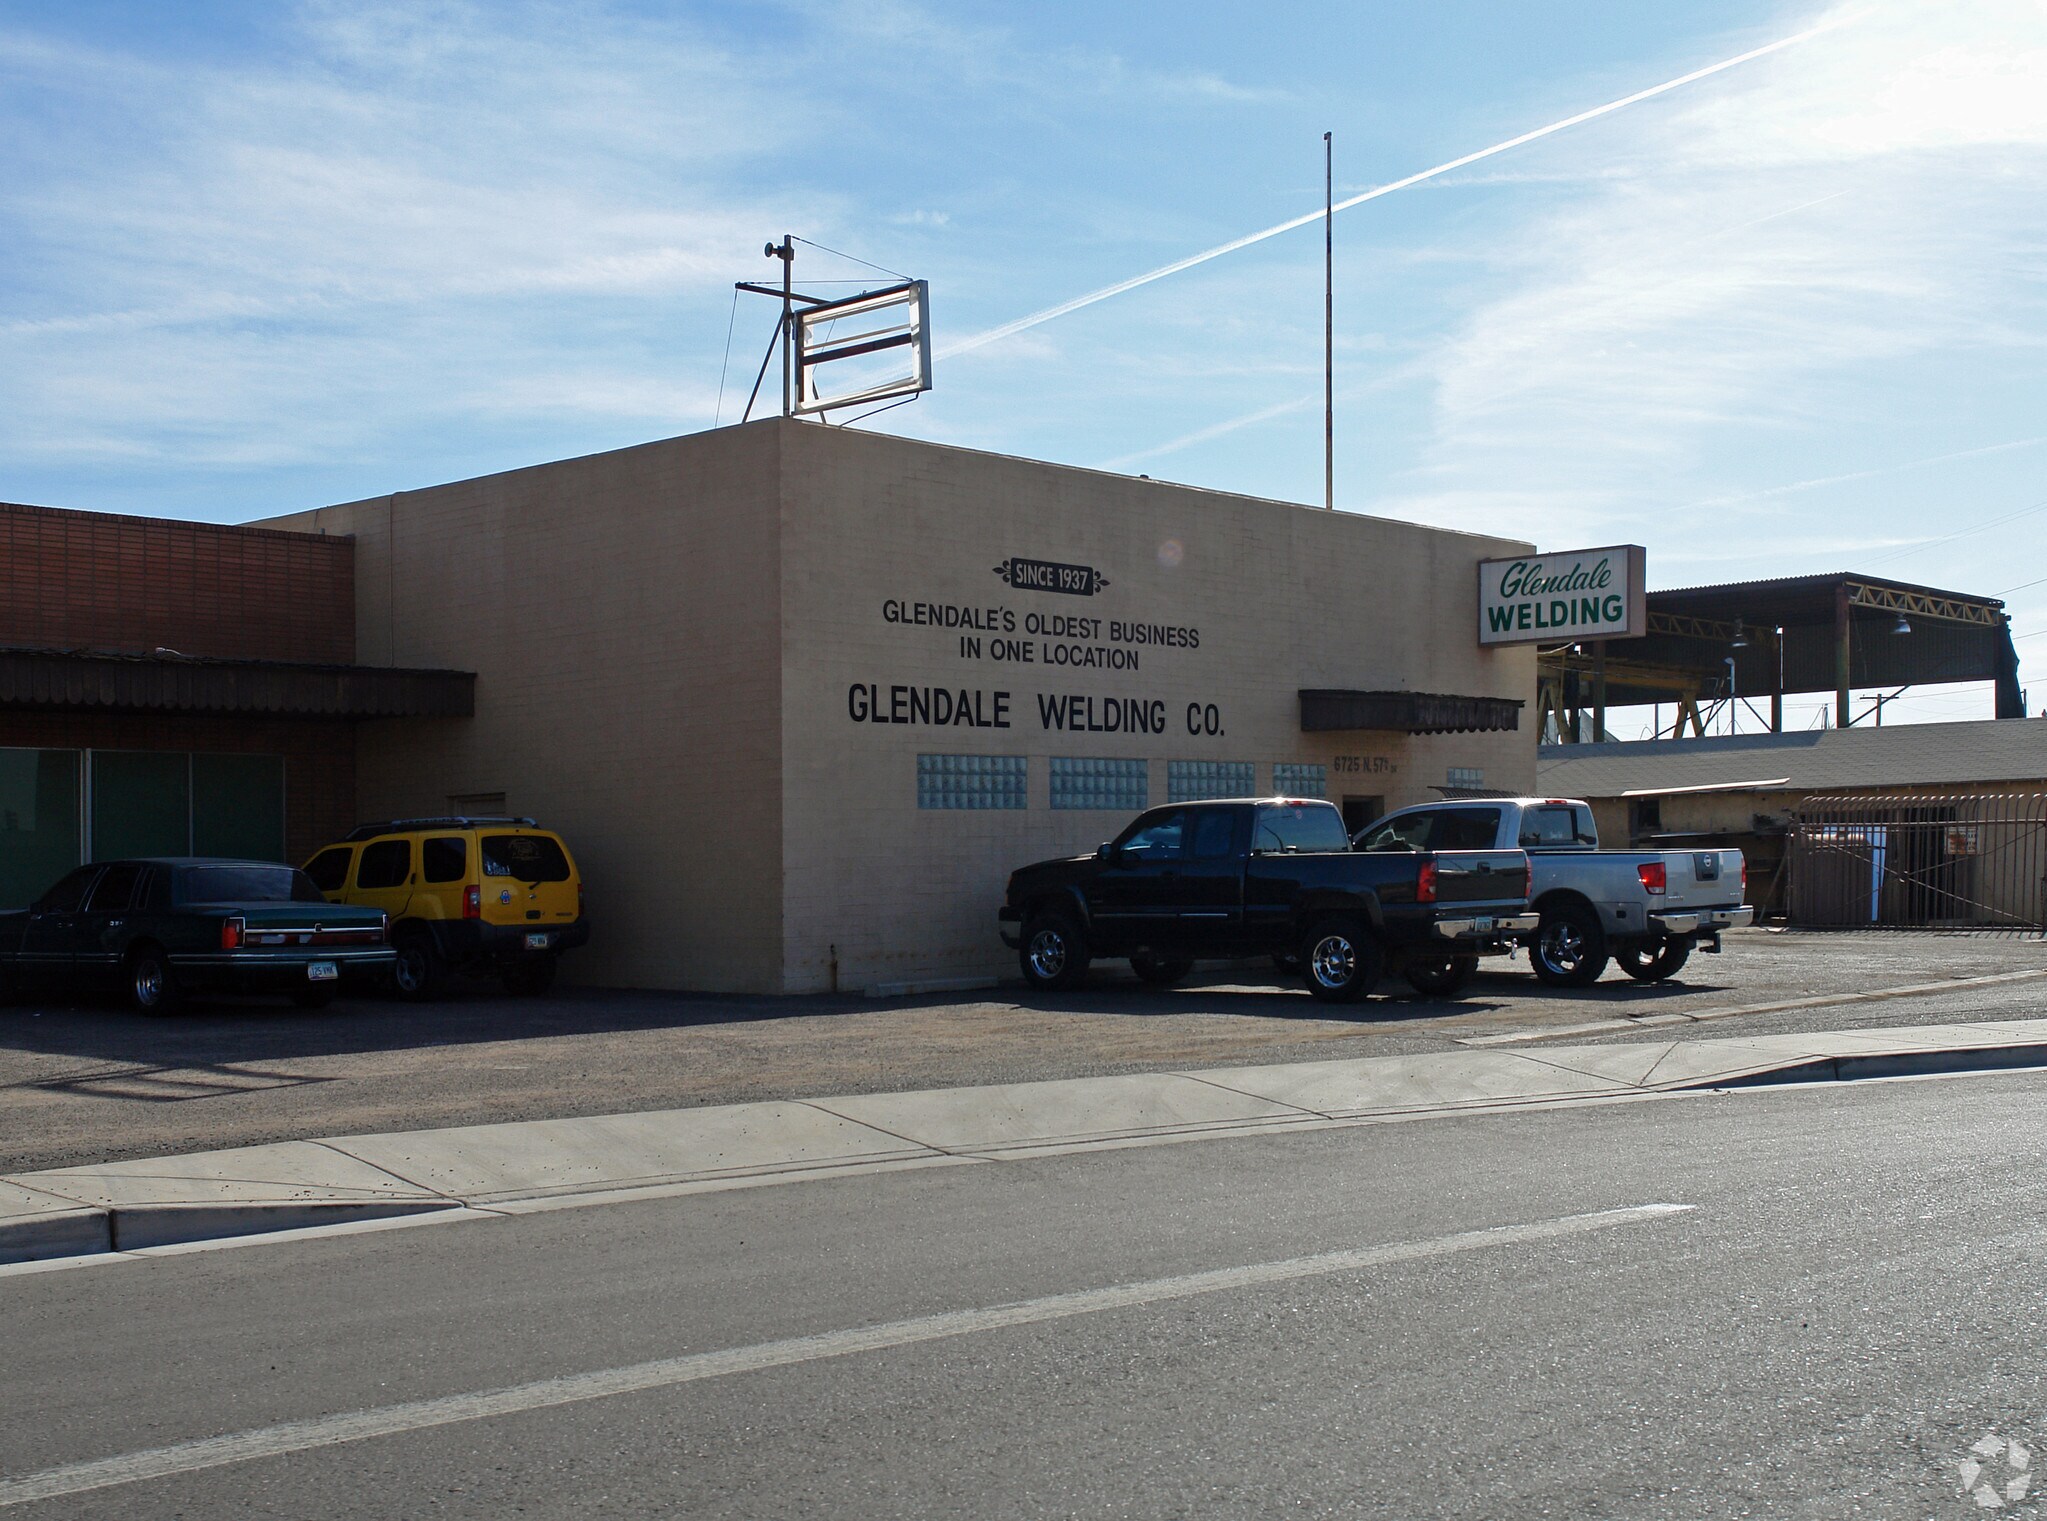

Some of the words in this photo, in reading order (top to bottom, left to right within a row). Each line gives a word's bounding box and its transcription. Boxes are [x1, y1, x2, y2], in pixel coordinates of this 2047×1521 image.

[1015, 563, 1054, 588] SINCE
[1058, 567, 1089, 591] 1937
[1500, 558, 1612, 598] Glendale
[882, 599, 1016, 632] GLENDALE'S
[1025, 613, 1102, 640] OLDEST
[1110, 621, 1200, 649] BUSINESS
[1488, 594, 1623, 633] WELDING
[960, 636, 981, 660] IN
[990, 638, 1034, 663] ONE
[1043, 643, 1140, 671] LOCATION
[848, 683, 1011, 729] GLENDALE
[1038, 693, 1166, 734] WELDING
[1186, 702, 1226, 736] CO.
[1334, 755, 1360, 773] 6725
